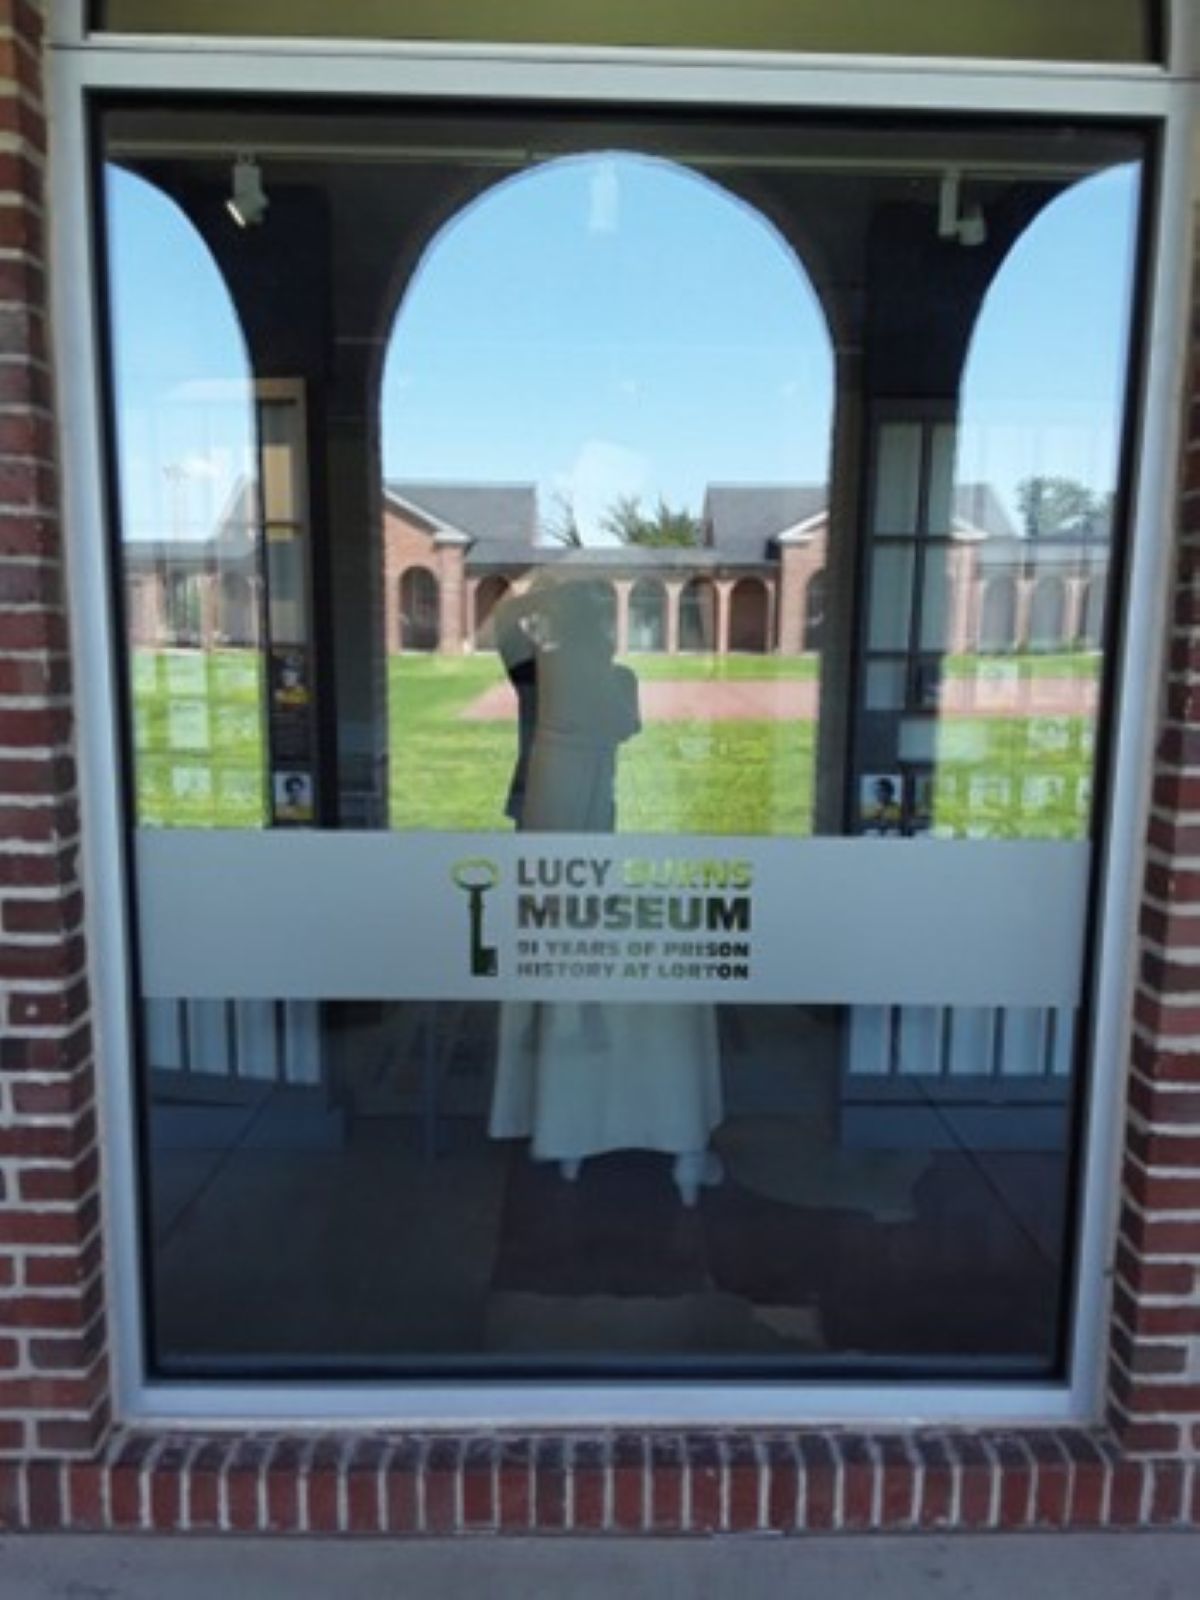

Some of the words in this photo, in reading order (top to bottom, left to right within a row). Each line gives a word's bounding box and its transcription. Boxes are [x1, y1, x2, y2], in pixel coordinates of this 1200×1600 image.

[517, 857, 612, 887] LUCY
[622, 857, 754, 889] BURNS
[517, 894, 751, 931] MUSEUM
[546, 941, 619, 957] YEARS
[627, 941, 656, 957] OF
[664, 941, 749, 958] PRISON
[517, 962, 614, 978] HISTORY
[623, 962, 650, 978] AT
[657, 962, 749, 979] LORTON
